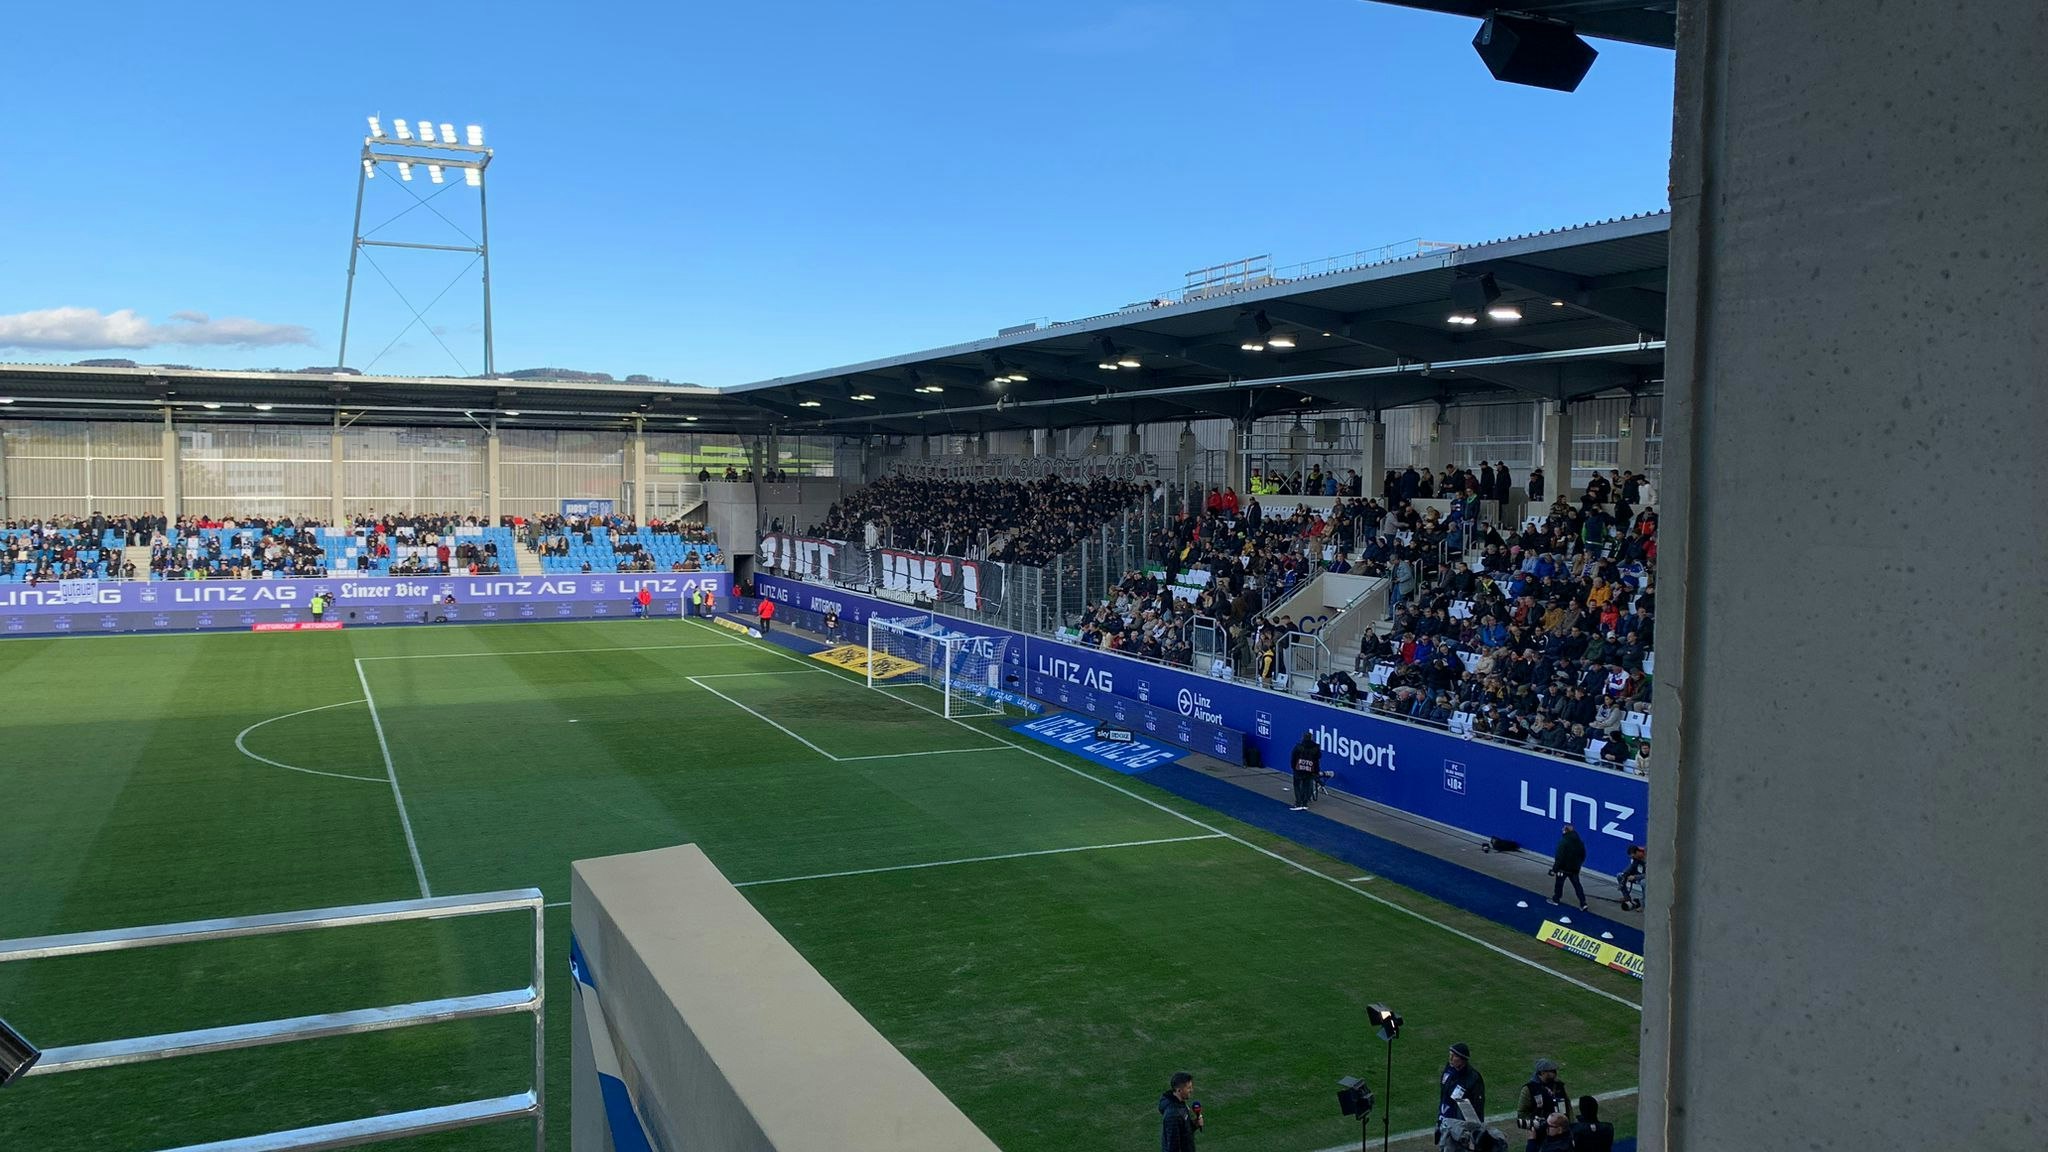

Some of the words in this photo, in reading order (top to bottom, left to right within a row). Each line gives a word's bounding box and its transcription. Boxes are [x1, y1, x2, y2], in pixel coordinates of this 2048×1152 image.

[176, 587, 246, 603] LINZ
[252, 586, 297, 601] AG
[340, 582, 391, 598] Linzer
[395, 582, 429, 597] Bier
[470, 582, 532, 596] LINZ
[537, 581, 577, 595] AG
[620, 579, 677, 593] LINZ
[682, 578, 718, 592] AG
[760, 583, 776, 599] LINZ
[777, 588, 788, 602] AG
[1039, 654, 1080, 684] LINZ
[1084, 667, 1113, 693] AG
[1193, 692, 1211, 709] Linz
[1193, 707, 1223, 726] Airport
[1309, 725, 1396, 771] uhlsport
[1520, 779, 1635, 842] LINZ
